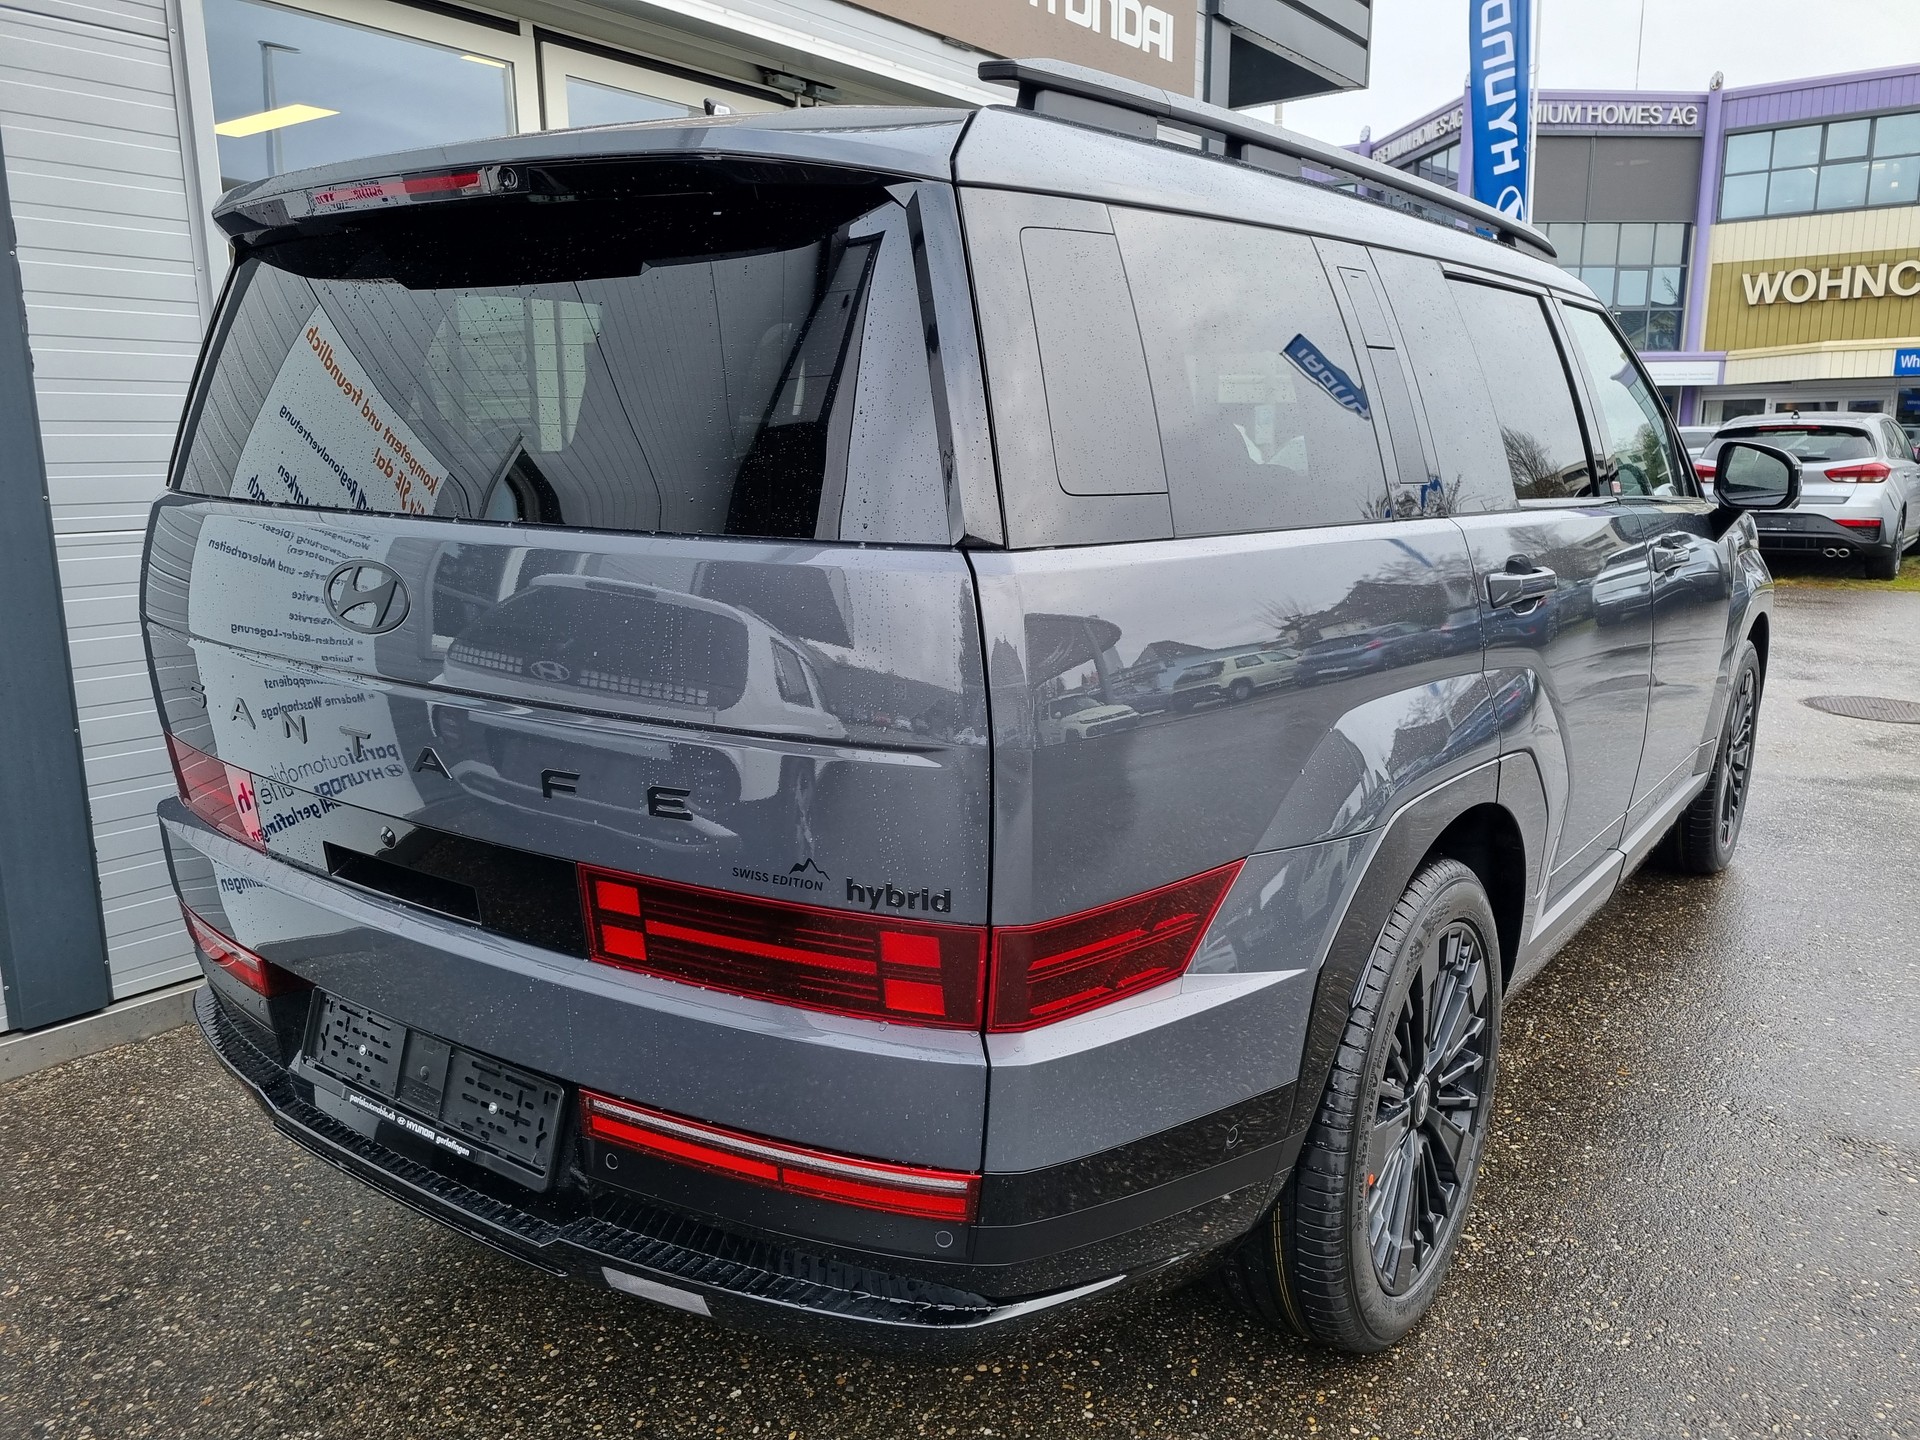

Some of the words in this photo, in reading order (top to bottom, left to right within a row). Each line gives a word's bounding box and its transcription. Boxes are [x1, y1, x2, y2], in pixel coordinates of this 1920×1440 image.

[1029, 0, 1174, 62] UNDAI
[1586, 105, 1663, 124] HOMES
[1667, 106, 1698, 125] AG
[732, 867, 769, 883] SWISS
[772, 873, 824, 891] EDITION
[846, 876, 951, 913] hybrid
[406, 1120, 435, 1140] HYUNDAI
[435, 1136, 470, 1156] gerlafingen
